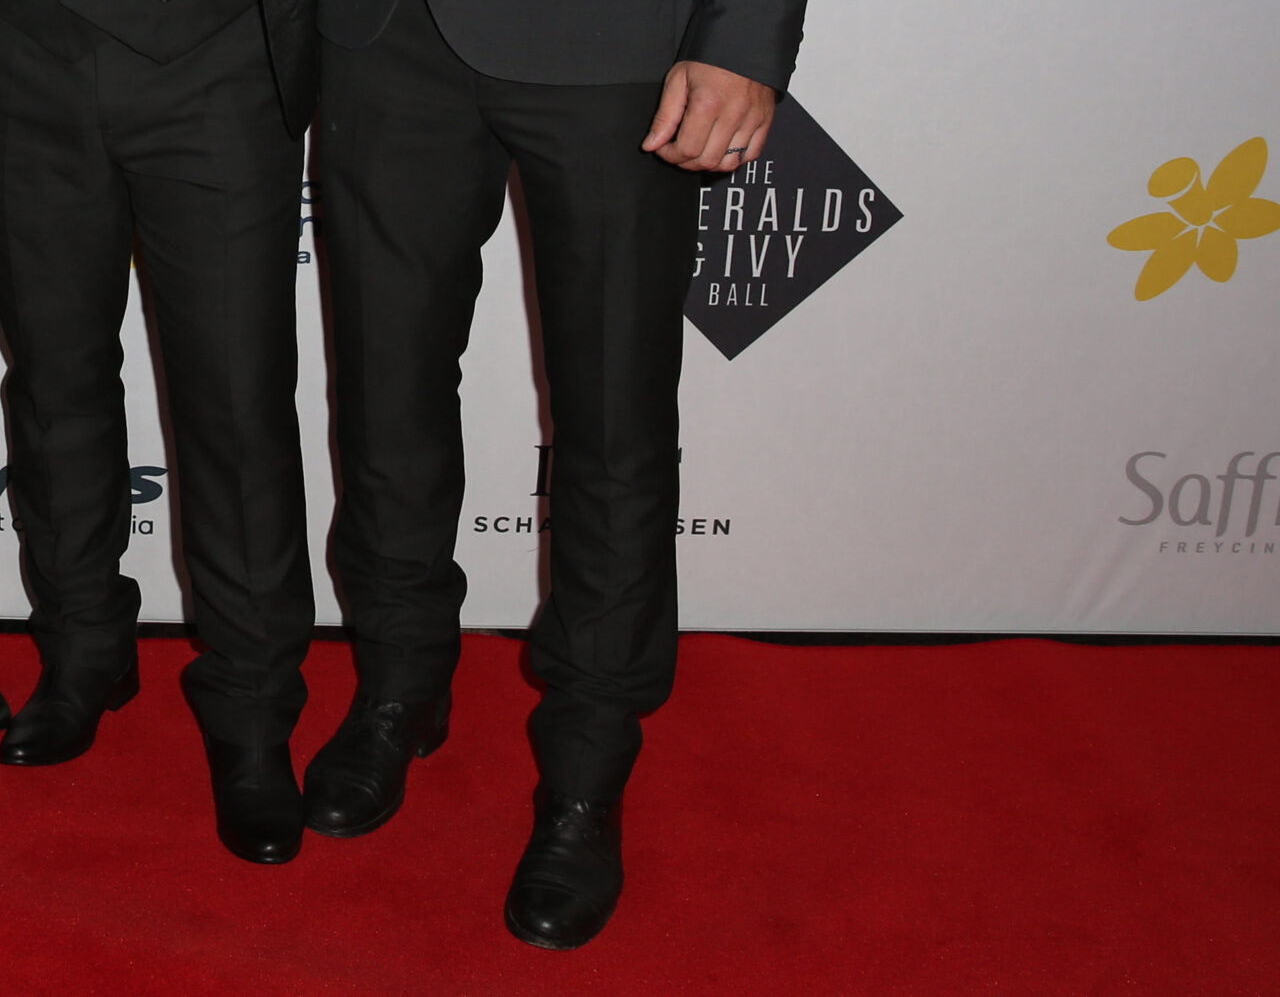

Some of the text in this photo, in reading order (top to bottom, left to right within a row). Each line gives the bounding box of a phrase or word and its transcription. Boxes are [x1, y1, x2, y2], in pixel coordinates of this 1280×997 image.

[723, 234, 804, 278] IVY
[708, 283, 769, 306] BALL
[1159, 542, 1276, 554] FREYCIN
